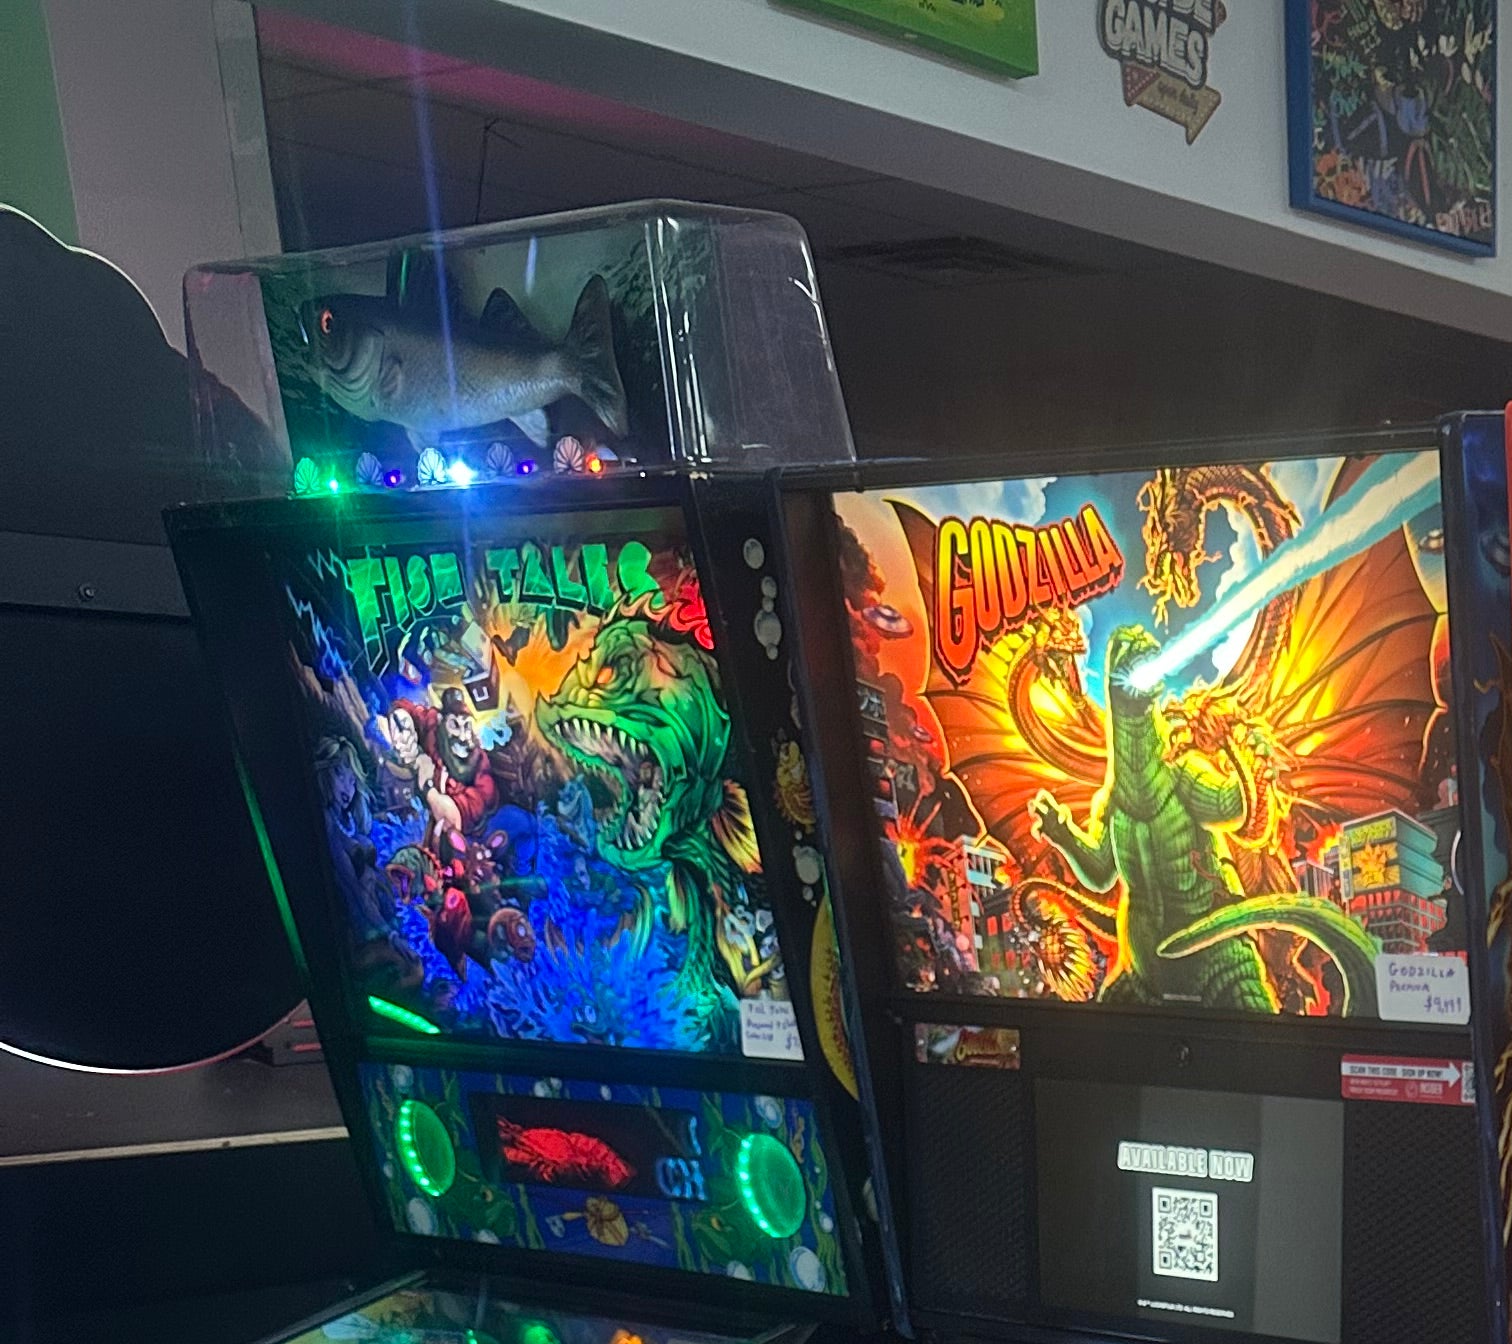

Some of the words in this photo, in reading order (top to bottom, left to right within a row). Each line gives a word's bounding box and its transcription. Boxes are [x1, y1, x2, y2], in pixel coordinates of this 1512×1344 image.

[1104, 0, 1205, 86] GAMES
[346, 551, 466, 655] FISH
[485, 540, 666, 614] TALES
[935, 504, 1123, 687] GODZILLA
[1120, 1144, 1207, 1176] AVAILABLE
[1209, 1151, 1253, 1181] NOW
